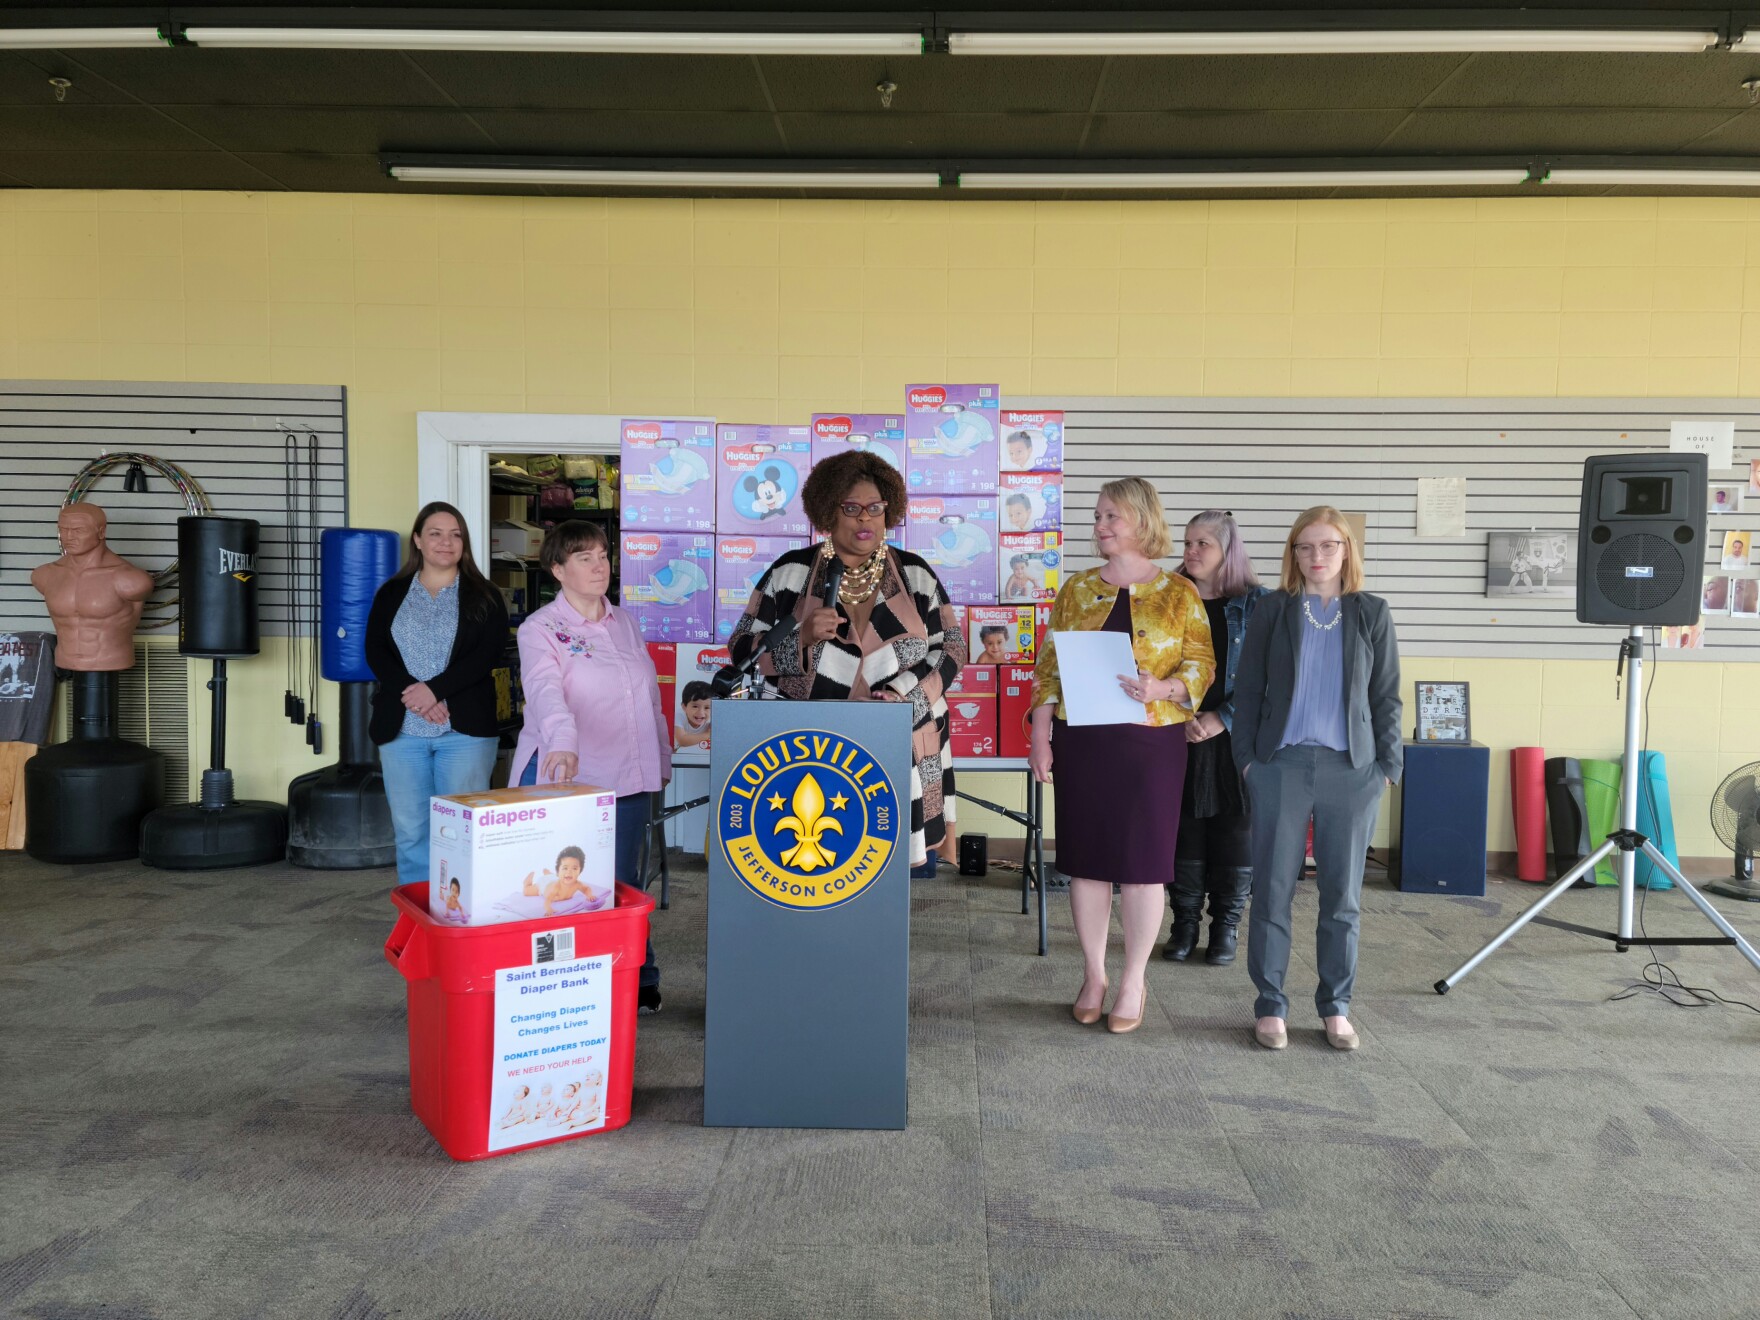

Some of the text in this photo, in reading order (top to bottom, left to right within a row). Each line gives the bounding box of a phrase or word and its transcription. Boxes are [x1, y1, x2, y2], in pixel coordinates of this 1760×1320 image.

[911, 394, 943, 403] HUGGIES
[1008, 412, 1045, 422] HUGGIES
[817, 423, 849, 433] HUGGIES
[626, 429, 659, 440] HUGGIES
[725, 451, 761, 461] HUGGIES
[1007, 474, 1043, 485] HUGGIES
[980, 482, 995, 490] 198
[909, 506, 941, 514] HUGGIES
[695, 520, 711, 529] 198
[791, 523, 807, 532] 198
[1003, 535, 1042, 545] HUGGIES
[625, 541, 658, 551] HUGGIES
[721, 545, 753, 554] HUGGIES
[978, 592, 993, 600] 198
[975, 609, 1013, 619] HUGGIES
[694, 630, 709, 638] 198
[983, 737, 993, 750] 2
[730, 735, 889, 802] LOUISVILLE
[432, 801, 456, 817] diapers
[478, 807, 547, 827] diapers
[602, 811, 609, 822] 2
[730, 803, 743, 829] 2003
[876, 806, 890, 831] 2003
[465, 824, 470, 834] 2
[738, 843, 879, 897] JEFFERSON COUNTY
[506, 961, 602, 982] Saint Bernadette
[520, 977, 589, 995] Diaper Bank
[510, 1003, 596, 1023] Changing Diapers
[518, 1019, 589, 1037] Changes Lives
[503, 1036, 607, 1062] DONATE DIAPERS TODAY
[507, 1055, 593, 1078] WE NEED YOUR HELP
